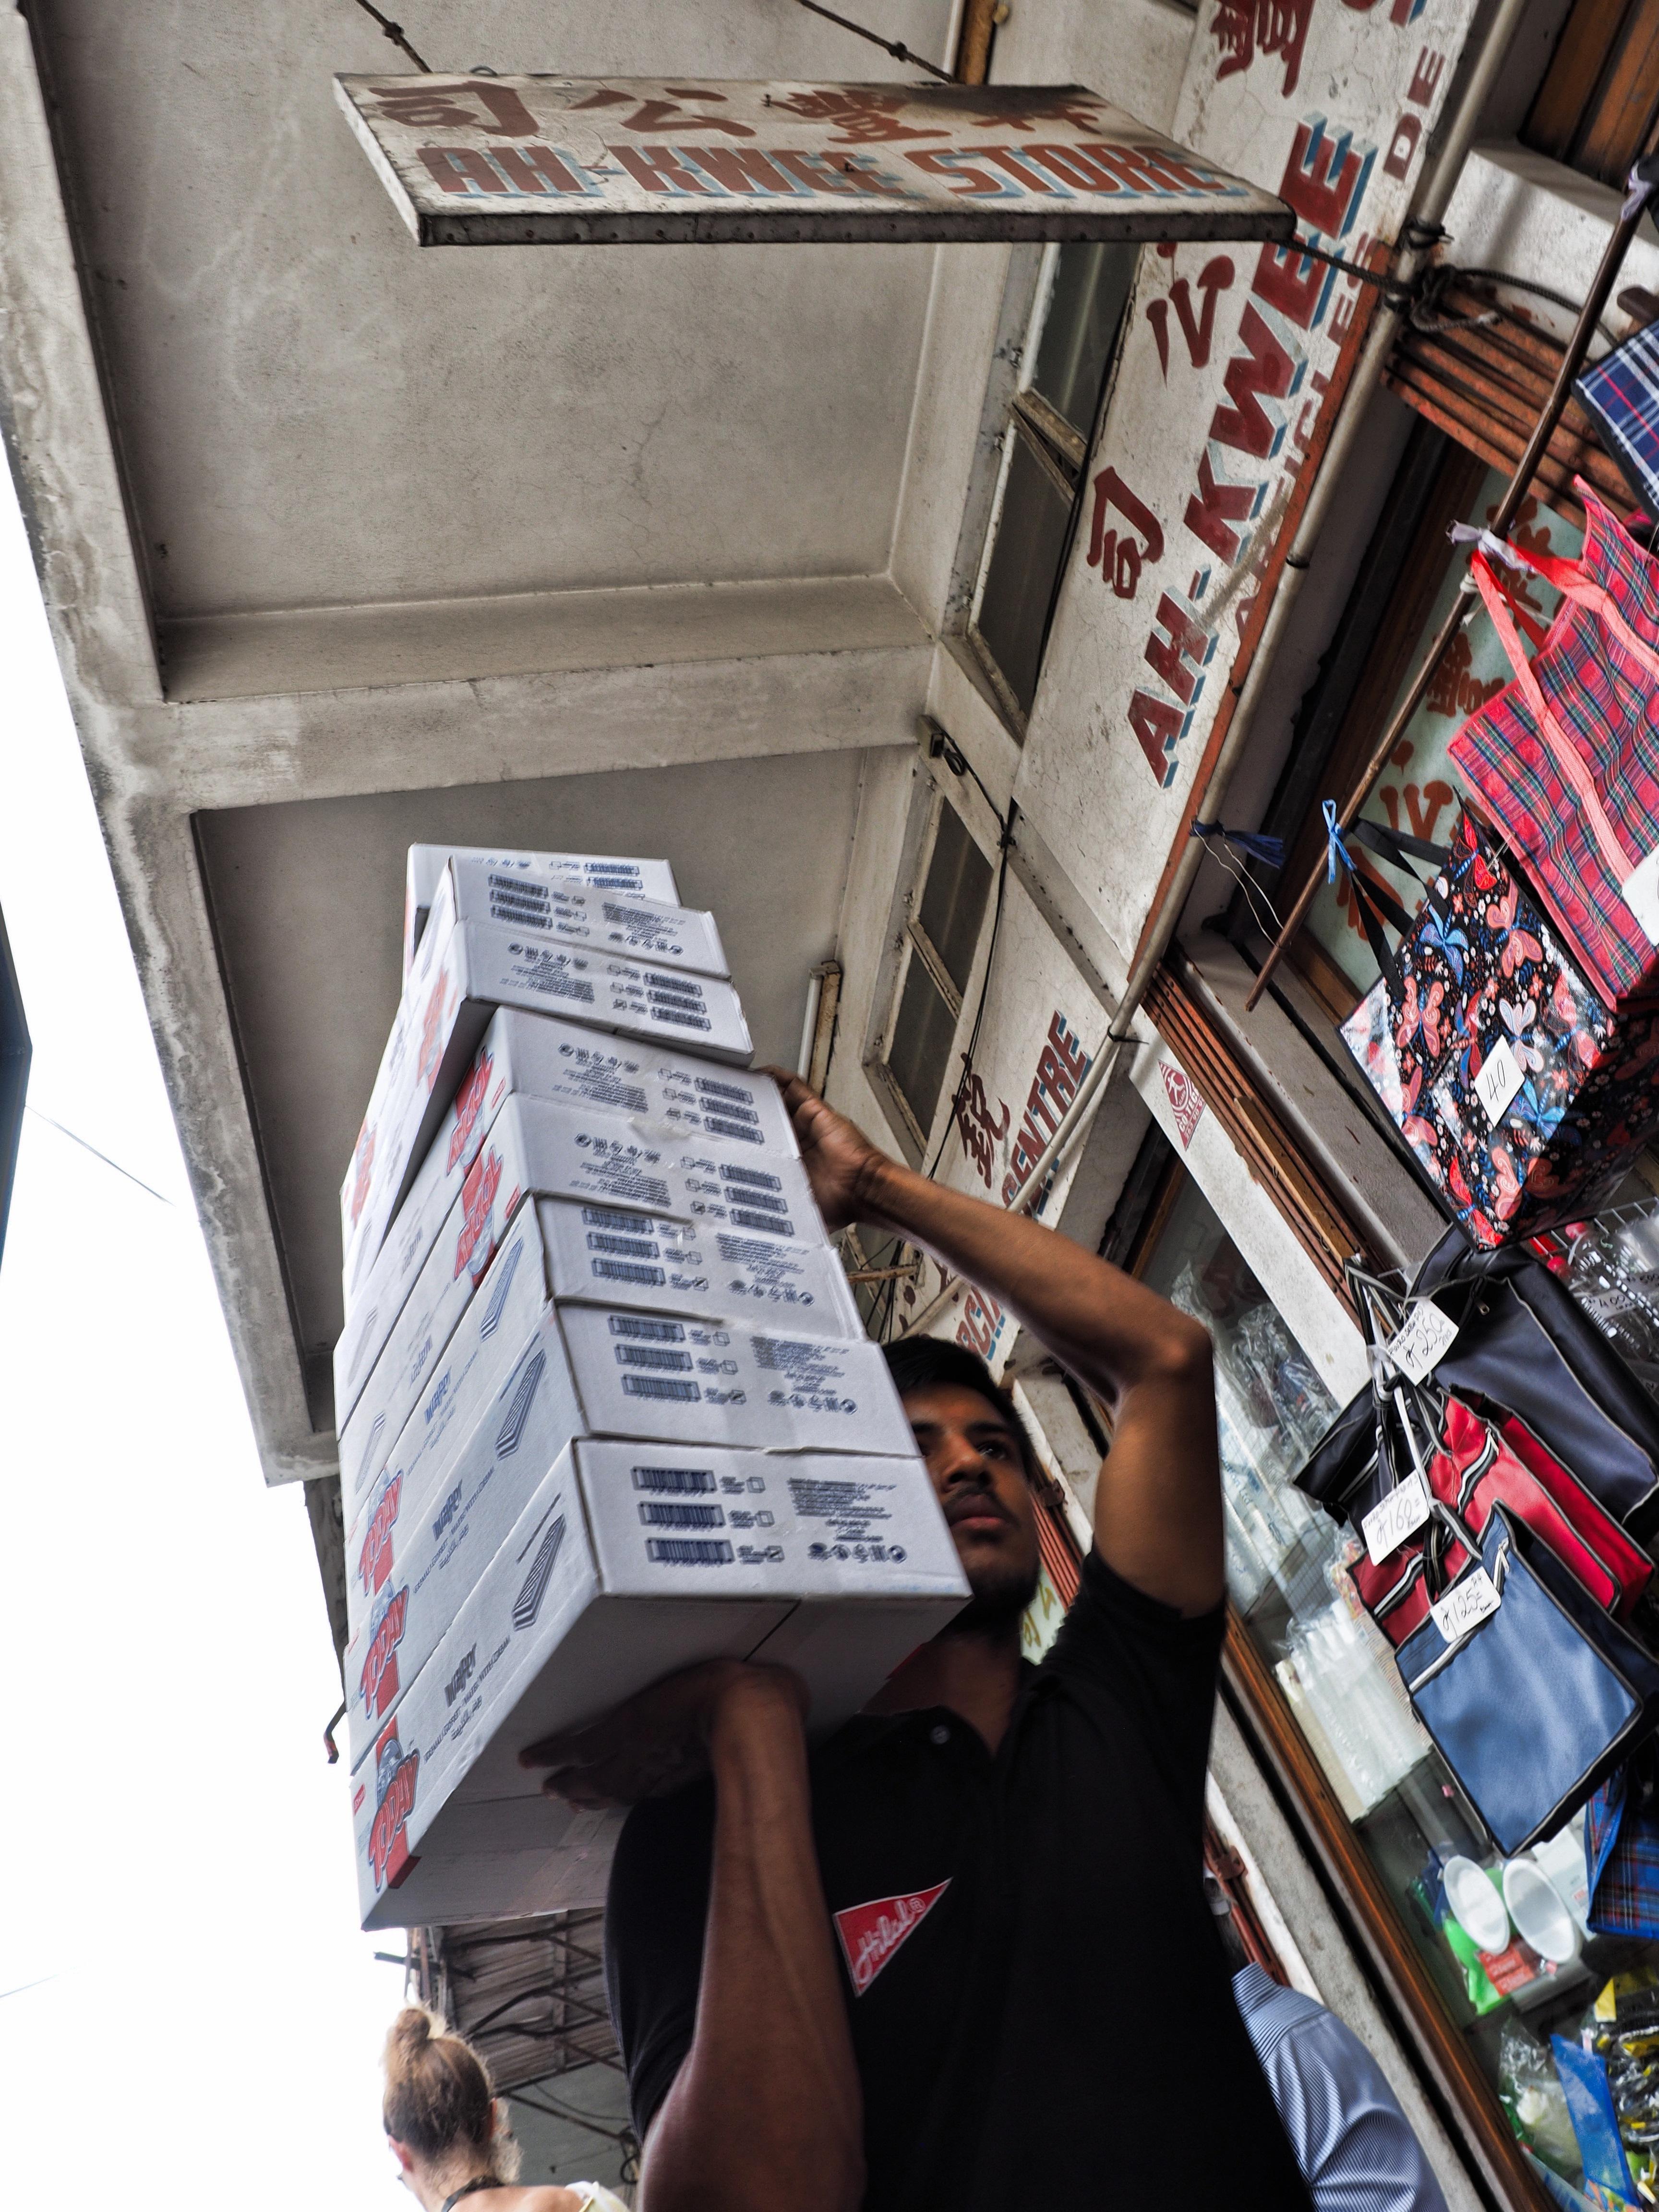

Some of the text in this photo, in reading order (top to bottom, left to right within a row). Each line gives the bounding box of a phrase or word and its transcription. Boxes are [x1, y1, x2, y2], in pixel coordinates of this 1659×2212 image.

[1383, 47, 1446, 180] DE
[417, 143, 1243, 198] AH-KWEE STORE
[1127, 110, 1378, 788] AH-KWEE
[1486, 1060, 1504, 1101] 40
